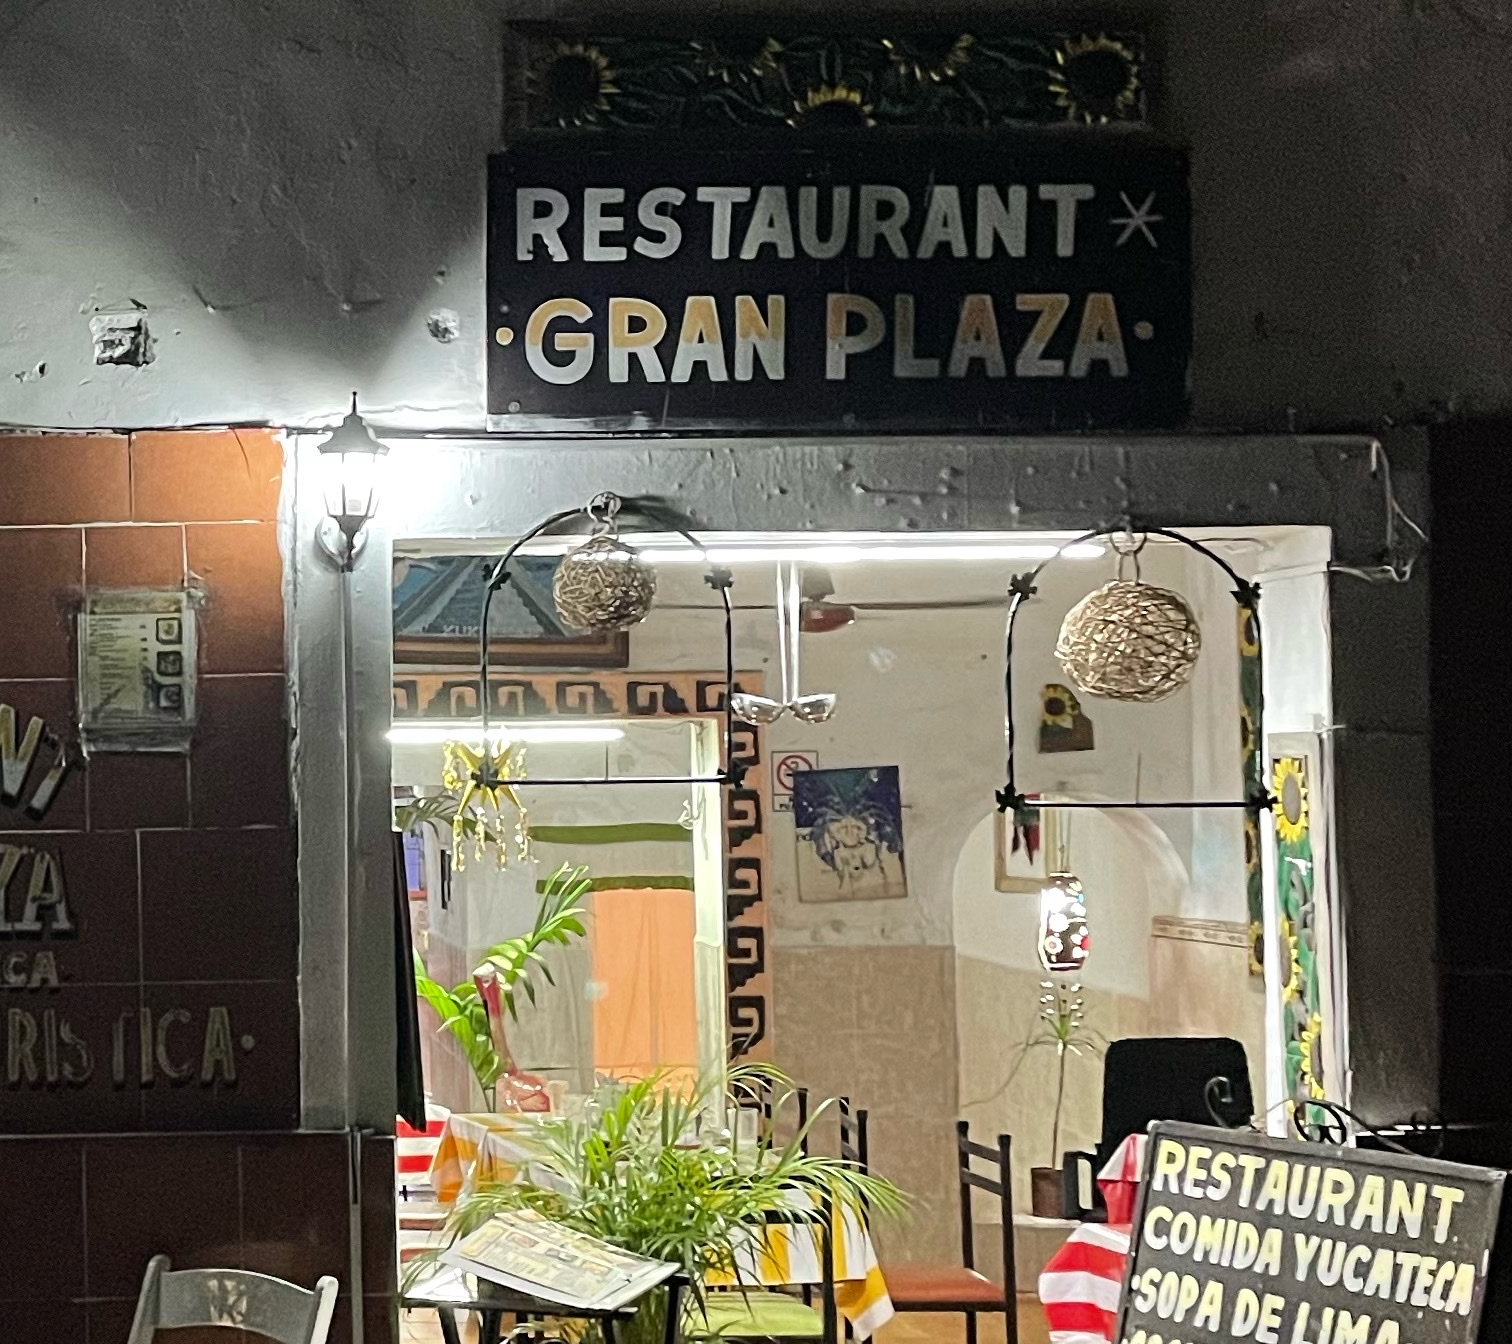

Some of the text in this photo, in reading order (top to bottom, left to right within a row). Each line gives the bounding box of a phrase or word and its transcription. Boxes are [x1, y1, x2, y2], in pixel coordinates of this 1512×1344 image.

[515, 184, 1095, 263] RESTAURANT
[524, 293, 1129, 385] GRAN PLAZA
[1152, 1139, 1465, 1244] RESTAURANT
[1134, 1267, 1224, 1333] SOPA
[1143, 1205, 1476, 1316] COMIDA YUCATECA
